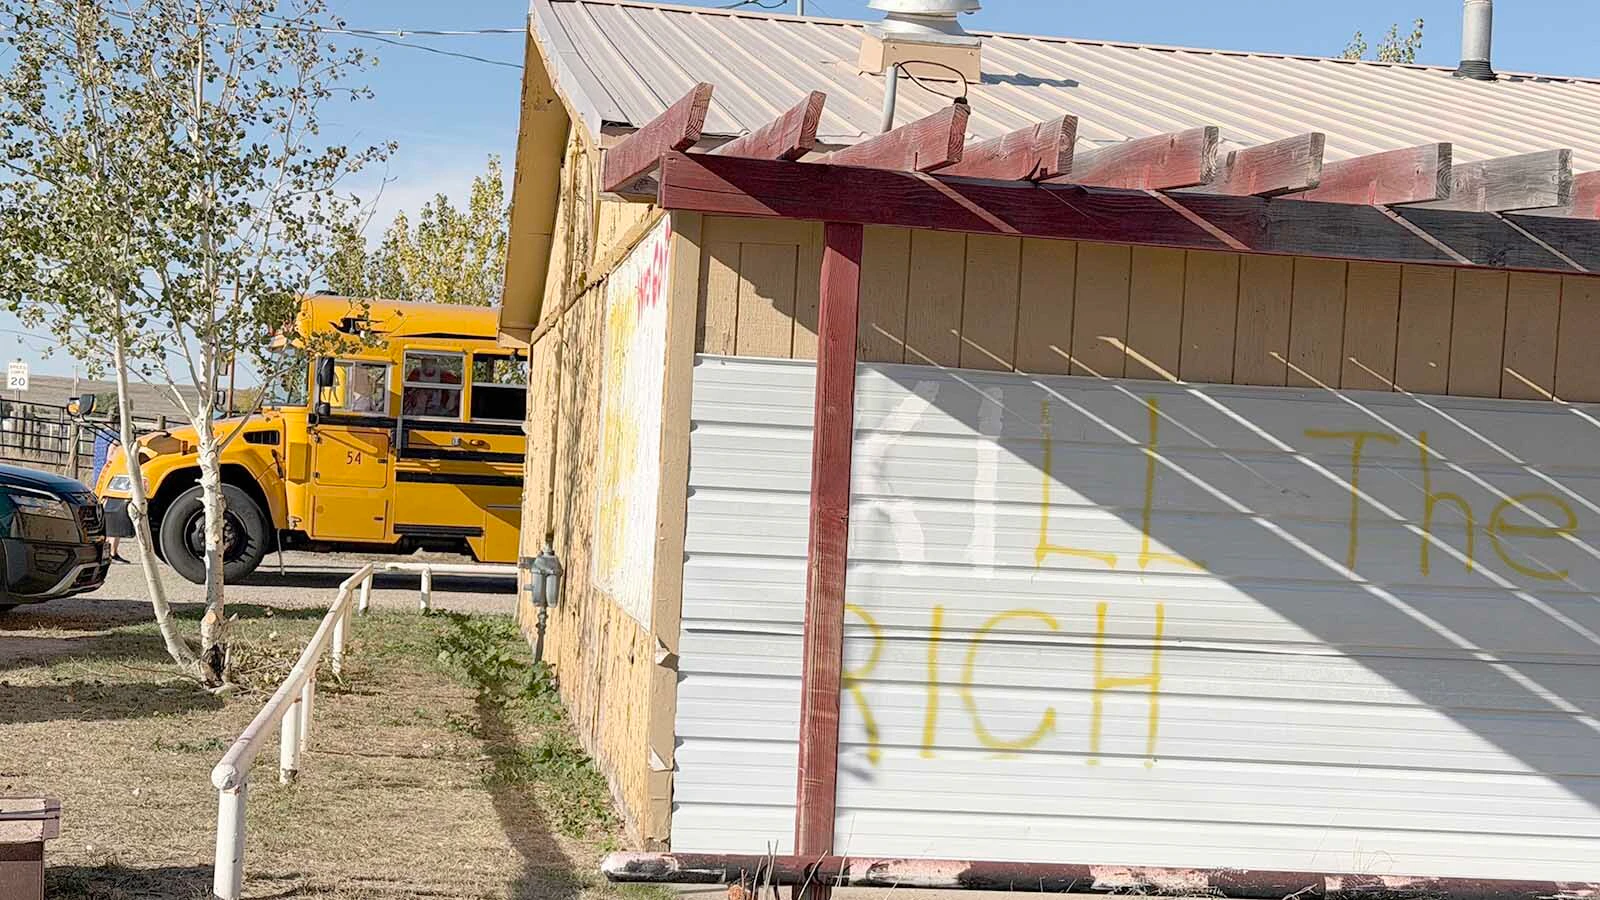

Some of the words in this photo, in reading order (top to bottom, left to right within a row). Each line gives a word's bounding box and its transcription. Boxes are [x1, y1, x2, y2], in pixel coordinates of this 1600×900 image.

[11, 376, 26, 386] 20
[346, 450, 361, 465] 54
[1304, 429, 1578, 582] The
[841, 601, 1165, 768] RICH
